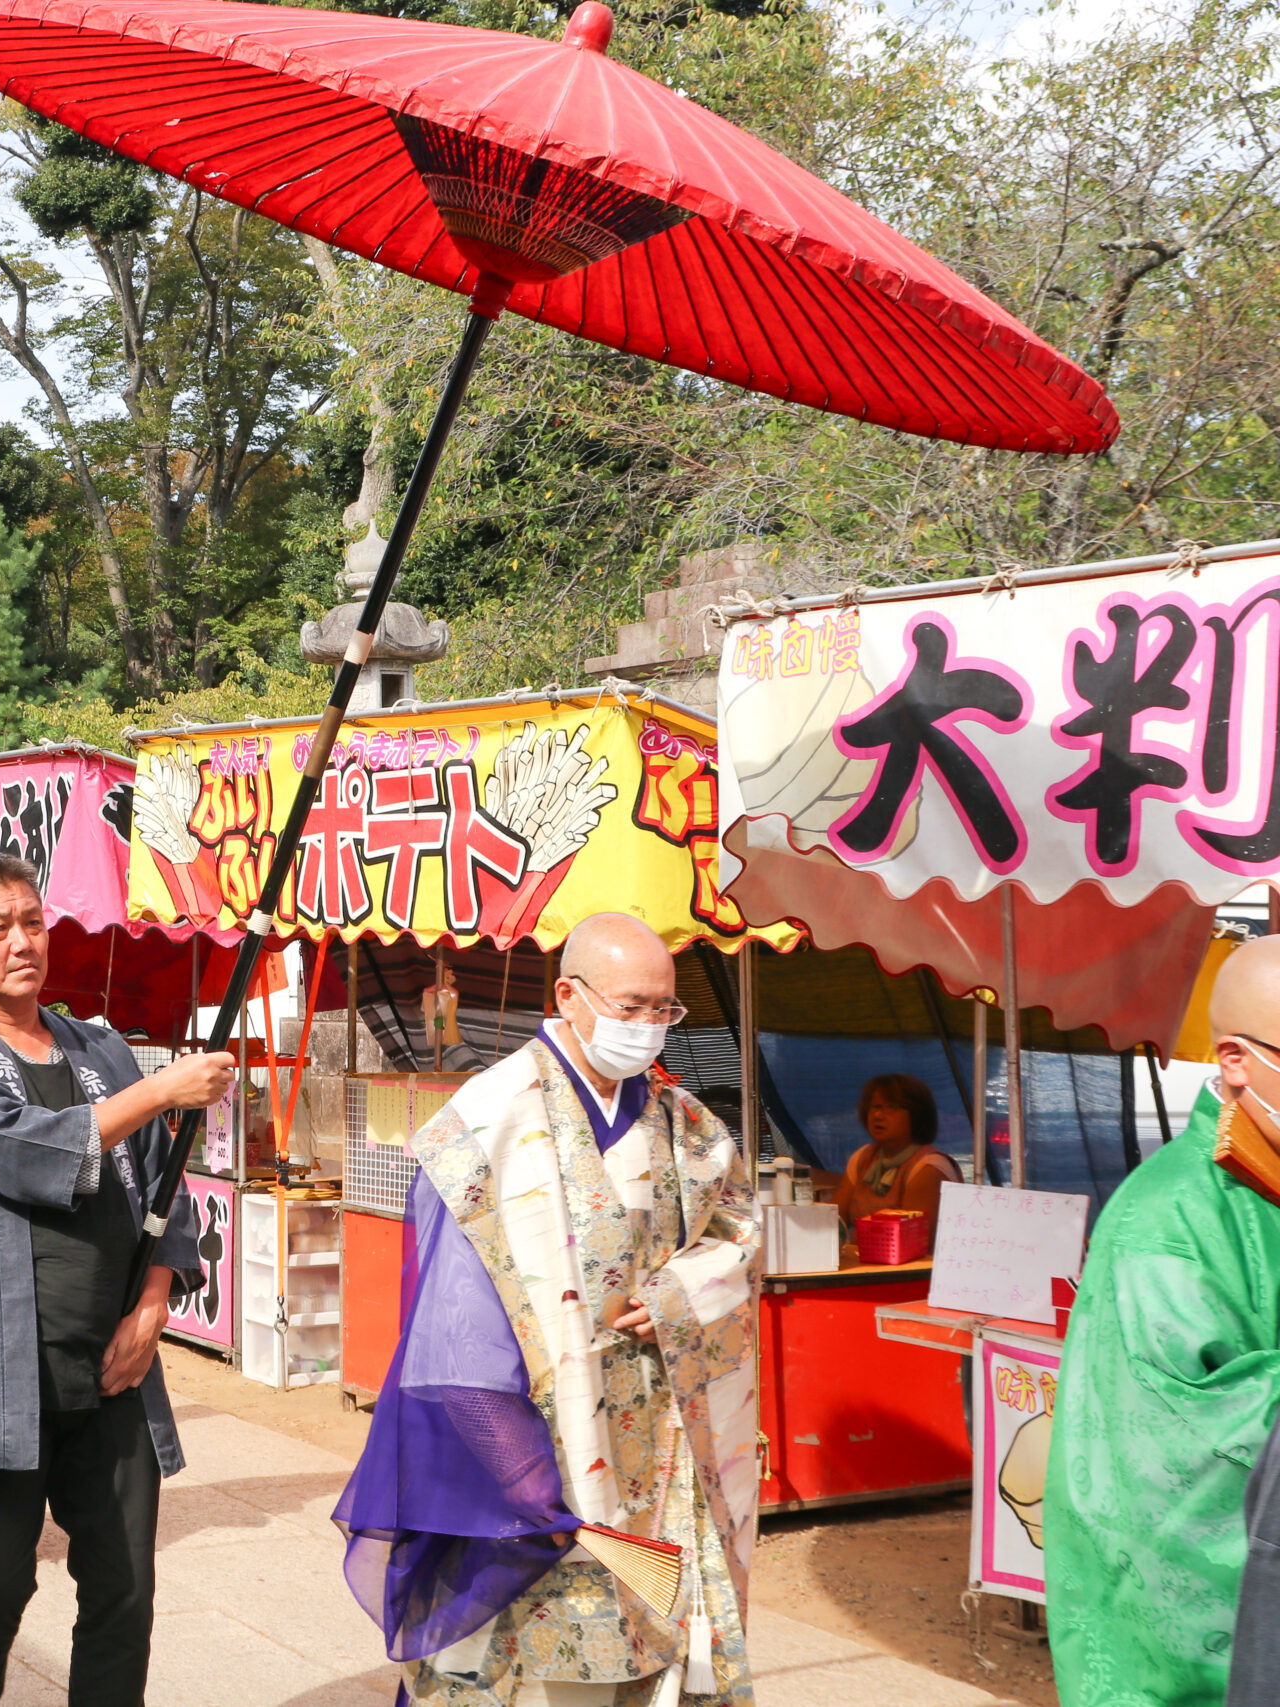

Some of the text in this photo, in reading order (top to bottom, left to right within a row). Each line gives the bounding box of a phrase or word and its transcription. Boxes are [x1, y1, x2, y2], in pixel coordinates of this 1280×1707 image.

[292, 727, 480, 773] めゃうまポテト！
[296, 763, 529, 931] ポテト
[968, 1191, 1055, 1216] 大判焼き
